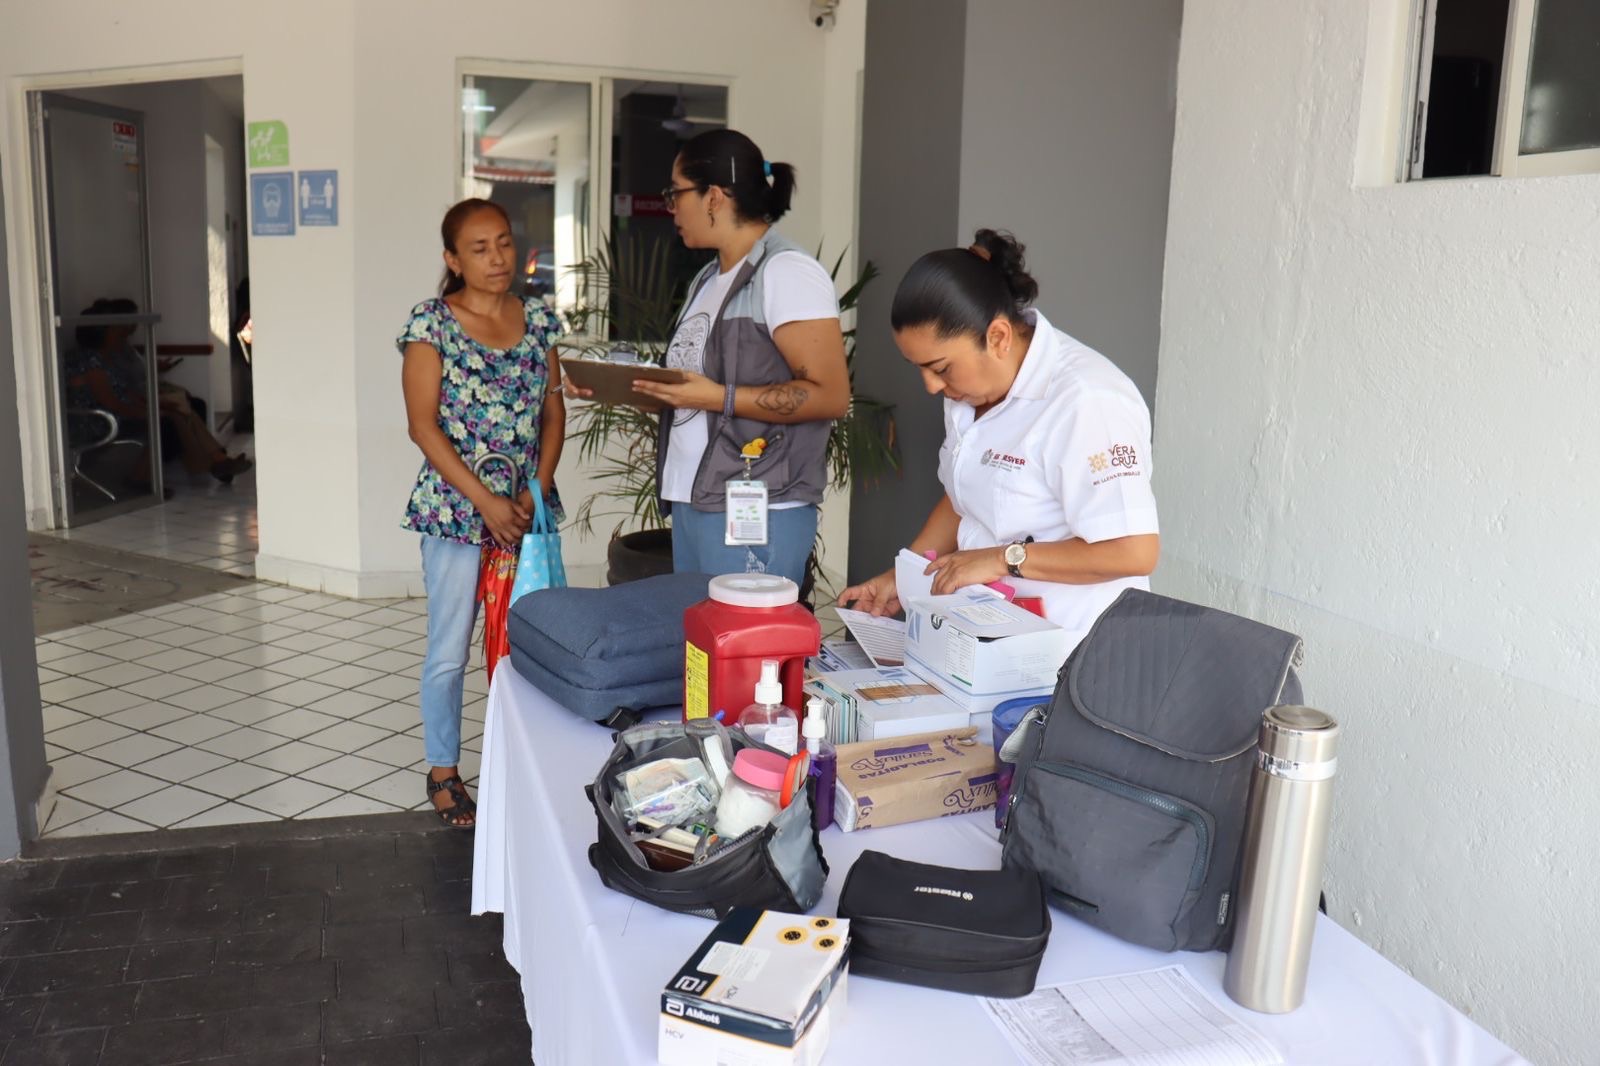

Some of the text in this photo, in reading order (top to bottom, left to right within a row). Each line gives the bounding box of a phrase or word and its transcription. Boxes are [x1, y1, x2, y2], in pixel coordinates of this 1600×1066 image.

[1108, 443, 1136, 457] VERA
[1111, 455, 1138, 469] CRUZ
[874, 751, 933, 764] Sanilux
[858, 757, 946, 780] DOBLADITAS
[685, 1007, 720, 1025] Abbott
[665, 1028, 685, 1039] HCV
